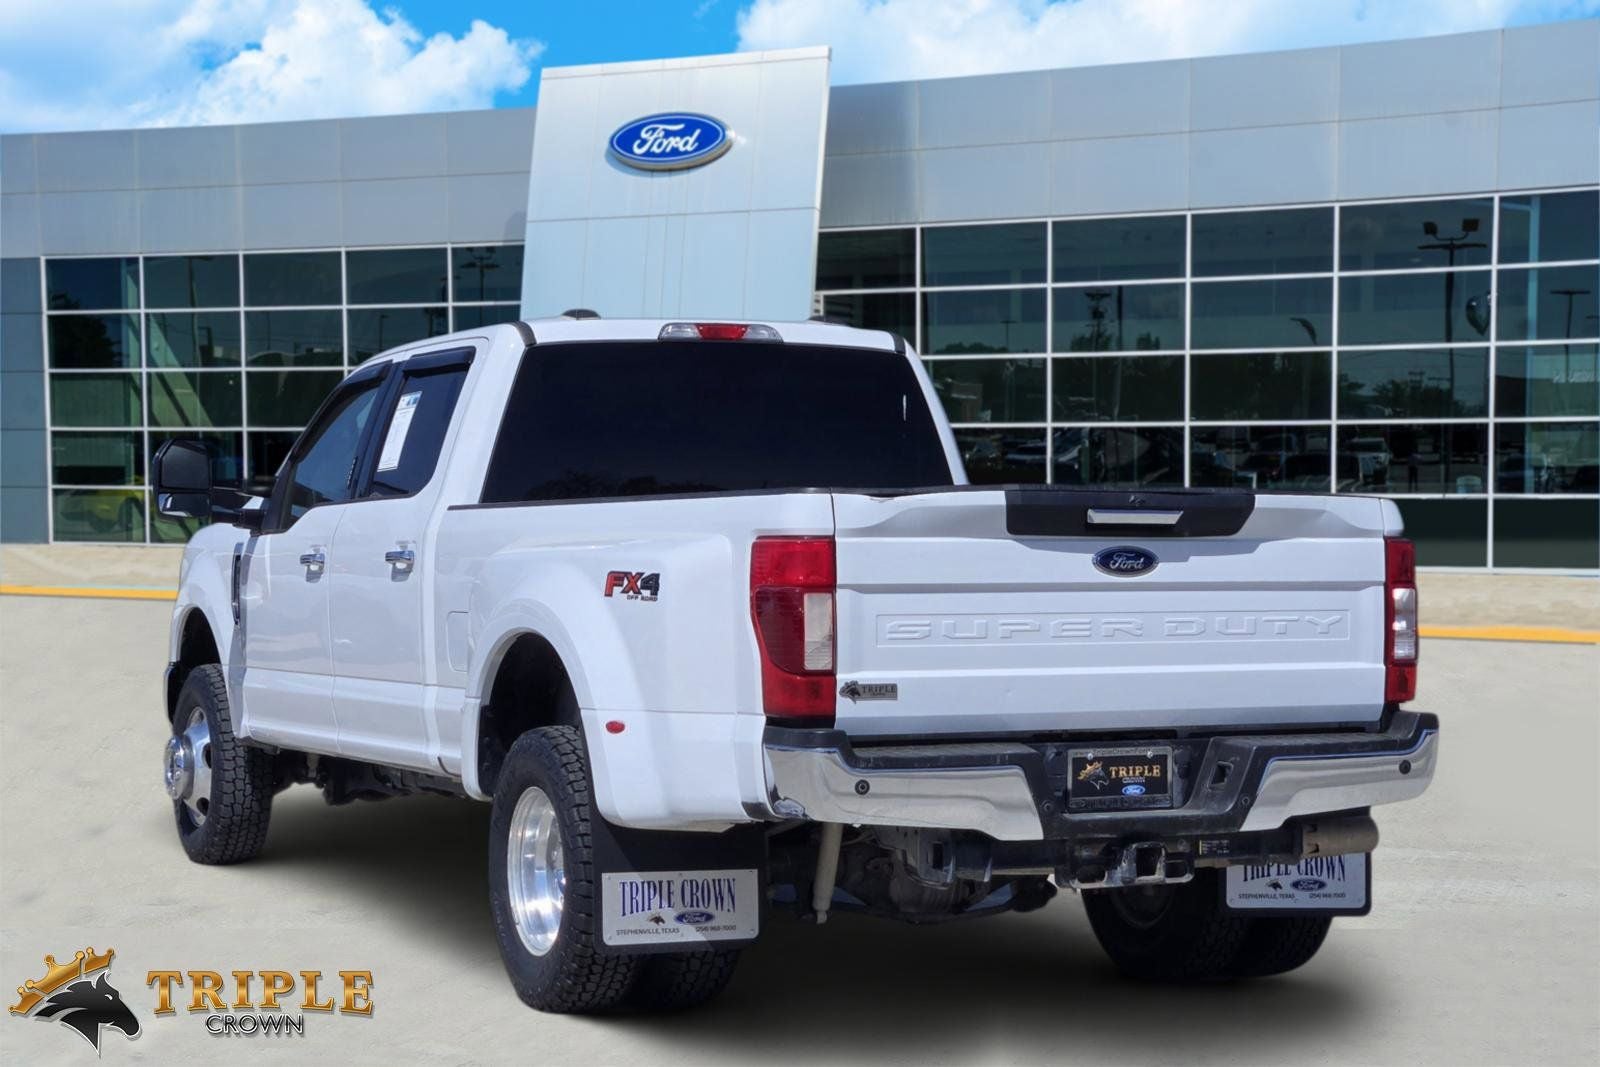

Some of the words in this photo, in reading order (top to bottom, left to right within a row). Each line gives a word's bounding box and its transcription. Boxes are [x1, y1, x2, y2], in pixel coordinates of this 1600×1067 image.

[632, 123, 701, 155] Ford
[1109, 552, 1145, 570] Ford
[604, 570, 660, 597] FX4
[886, 617, 1144, 641] SUPER
[1164, 615, 1343, 637] DUTY
[861, 685, 897, 694] TRIPLE
[1109, 765, 1161, 778] TRIPLE
[619, 880, 675, 917] TRIPLE
[681, 878, 736, 913] CROWN
